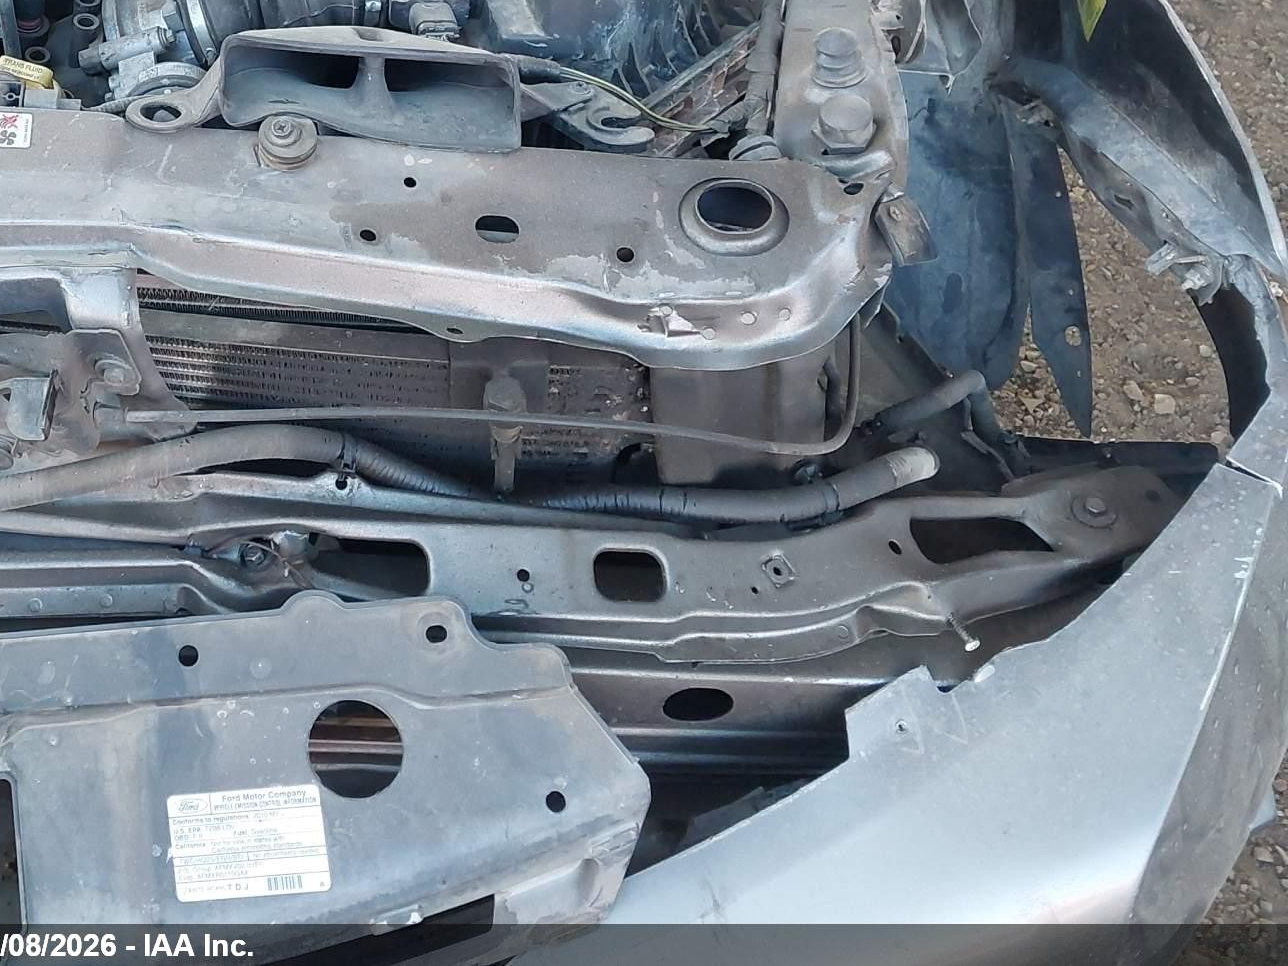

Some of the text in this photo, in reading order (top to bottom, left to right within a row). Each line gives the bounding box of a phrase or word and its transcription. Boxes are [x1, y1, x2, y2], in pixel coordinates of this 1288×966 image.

[222, 789, 306, 803] Ford Motor Company
